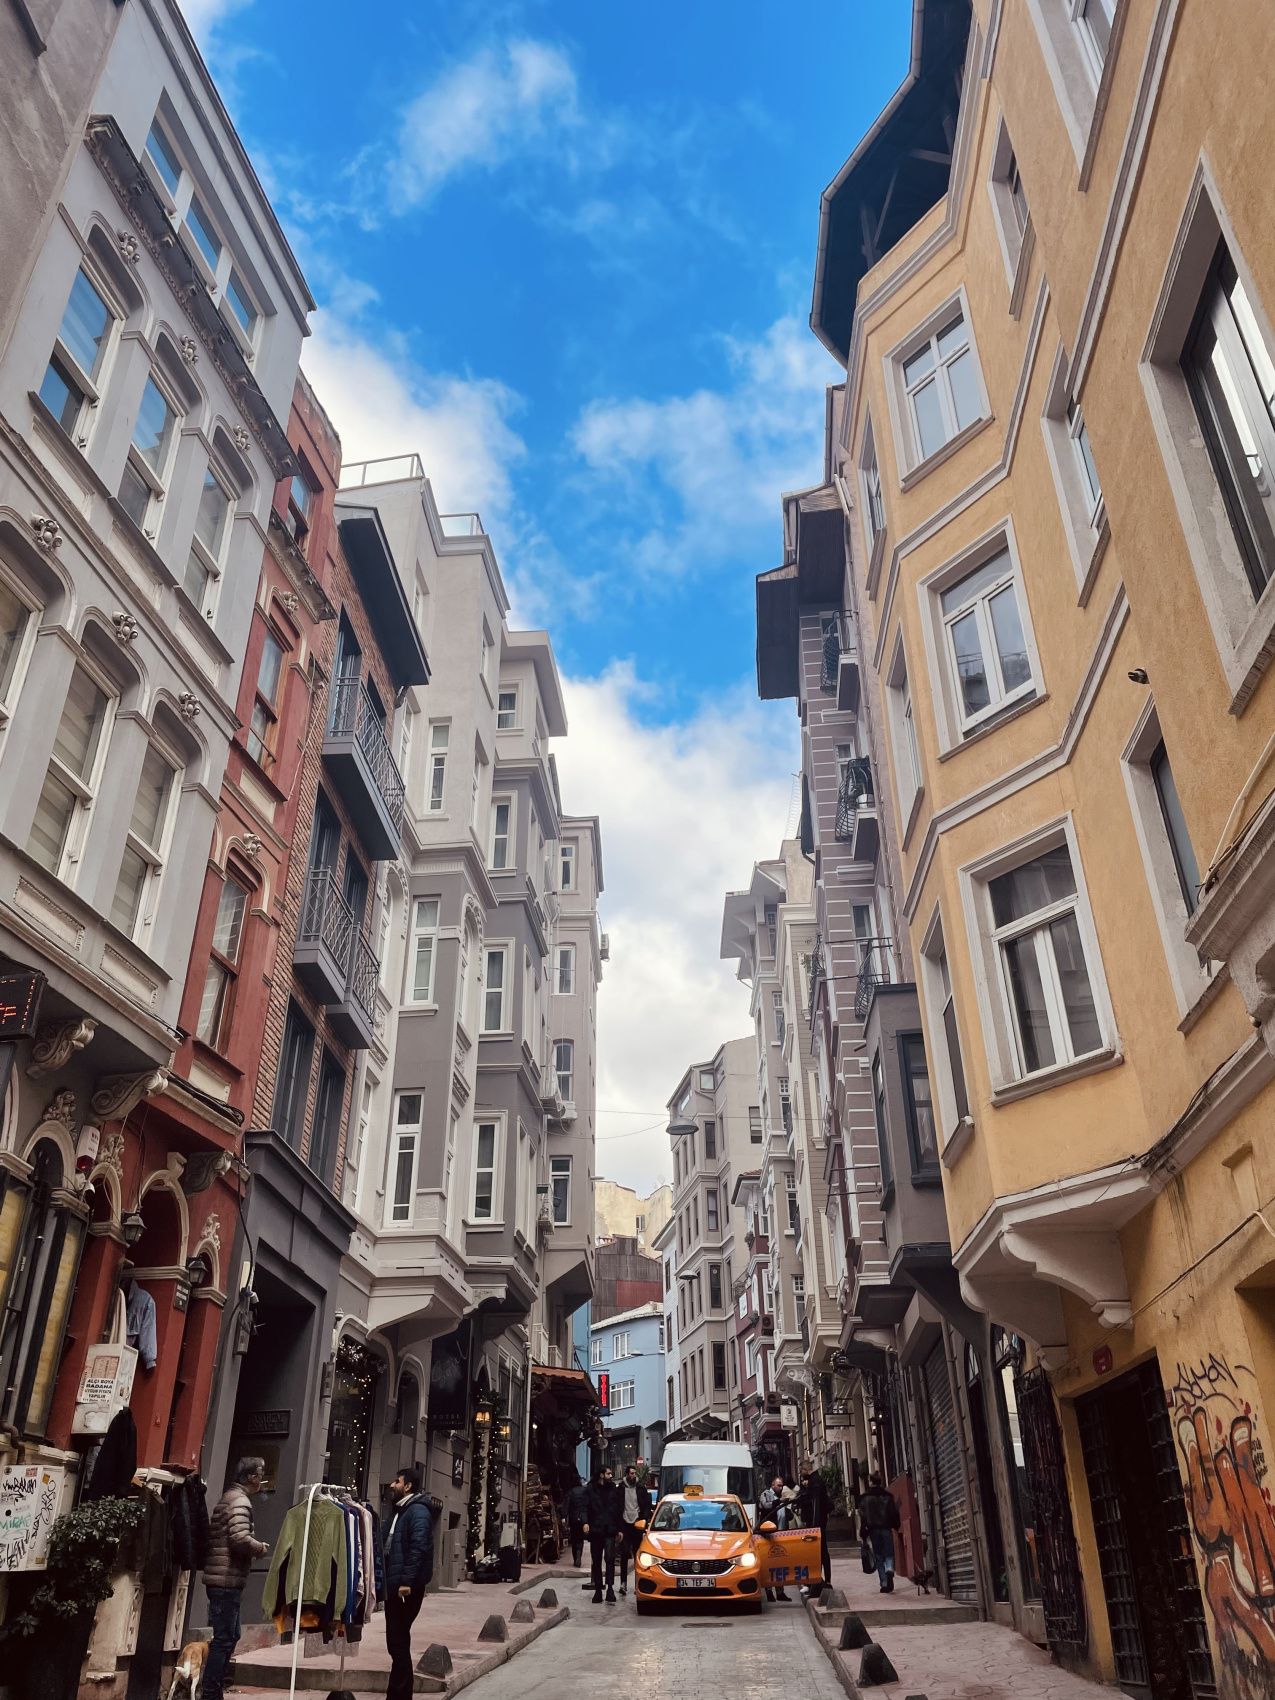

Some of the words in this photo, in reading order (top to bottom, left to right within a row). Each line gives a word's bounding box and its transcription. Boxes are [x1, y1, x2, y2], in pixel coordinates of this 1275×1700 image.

[769, 1566, 789, 1582] TEF
[794, 1565, 809, 1581] 34
[682, 1579, 688, 1587] 34
[693, 1579, 702, 1587] TEF
[708, 1579, 714, 1587] 34
